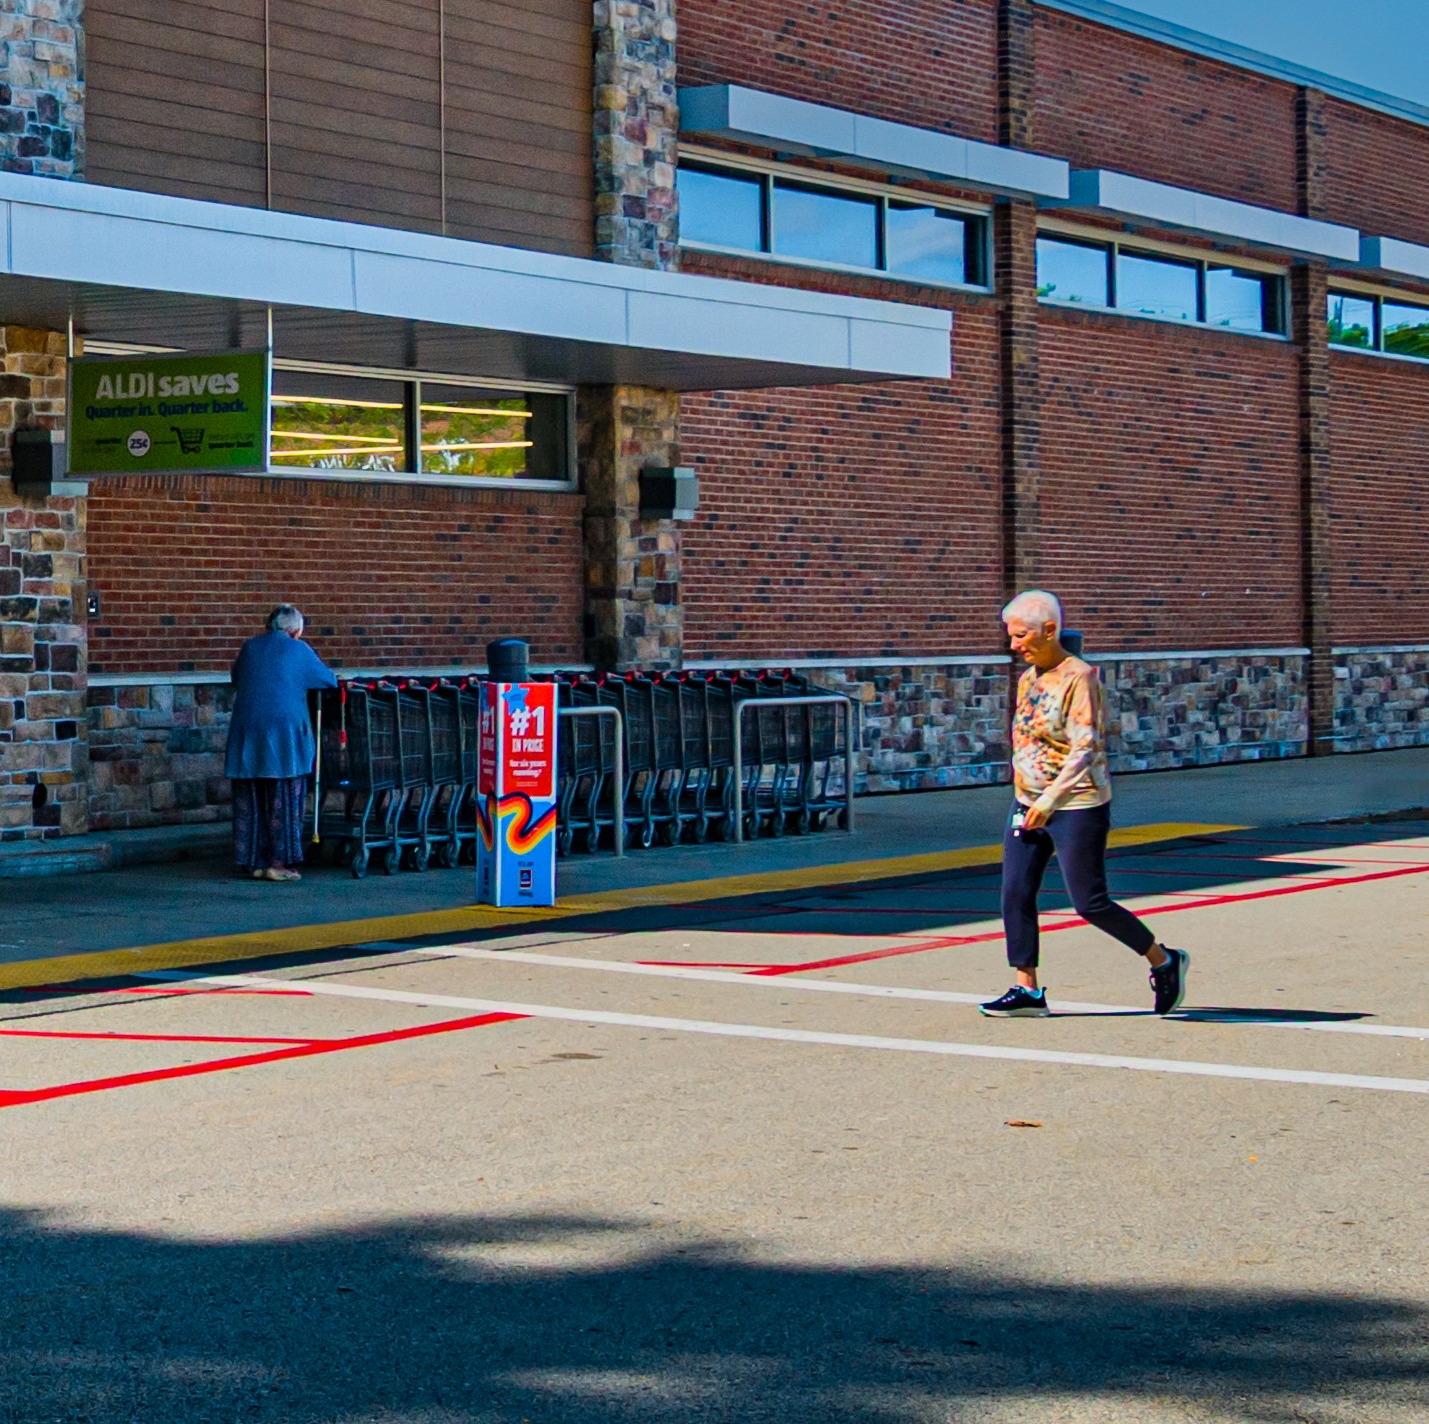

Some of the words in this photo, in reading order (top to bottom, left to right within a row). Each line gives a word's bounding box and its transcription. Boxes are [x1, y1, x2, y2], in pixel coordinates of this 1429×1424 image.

[96, 372, 154, 399] ALDI
[158, 372, 240, 397] saves
[85, 405, 136, 420] Quarter
[138, 402, 156, 416] in.
[158, 401, 208, 417] Quarter
[212, 399, 249, 413] back.
[509, 706, 546, 736] #1
[523, 738, 545, 753] PRICE
